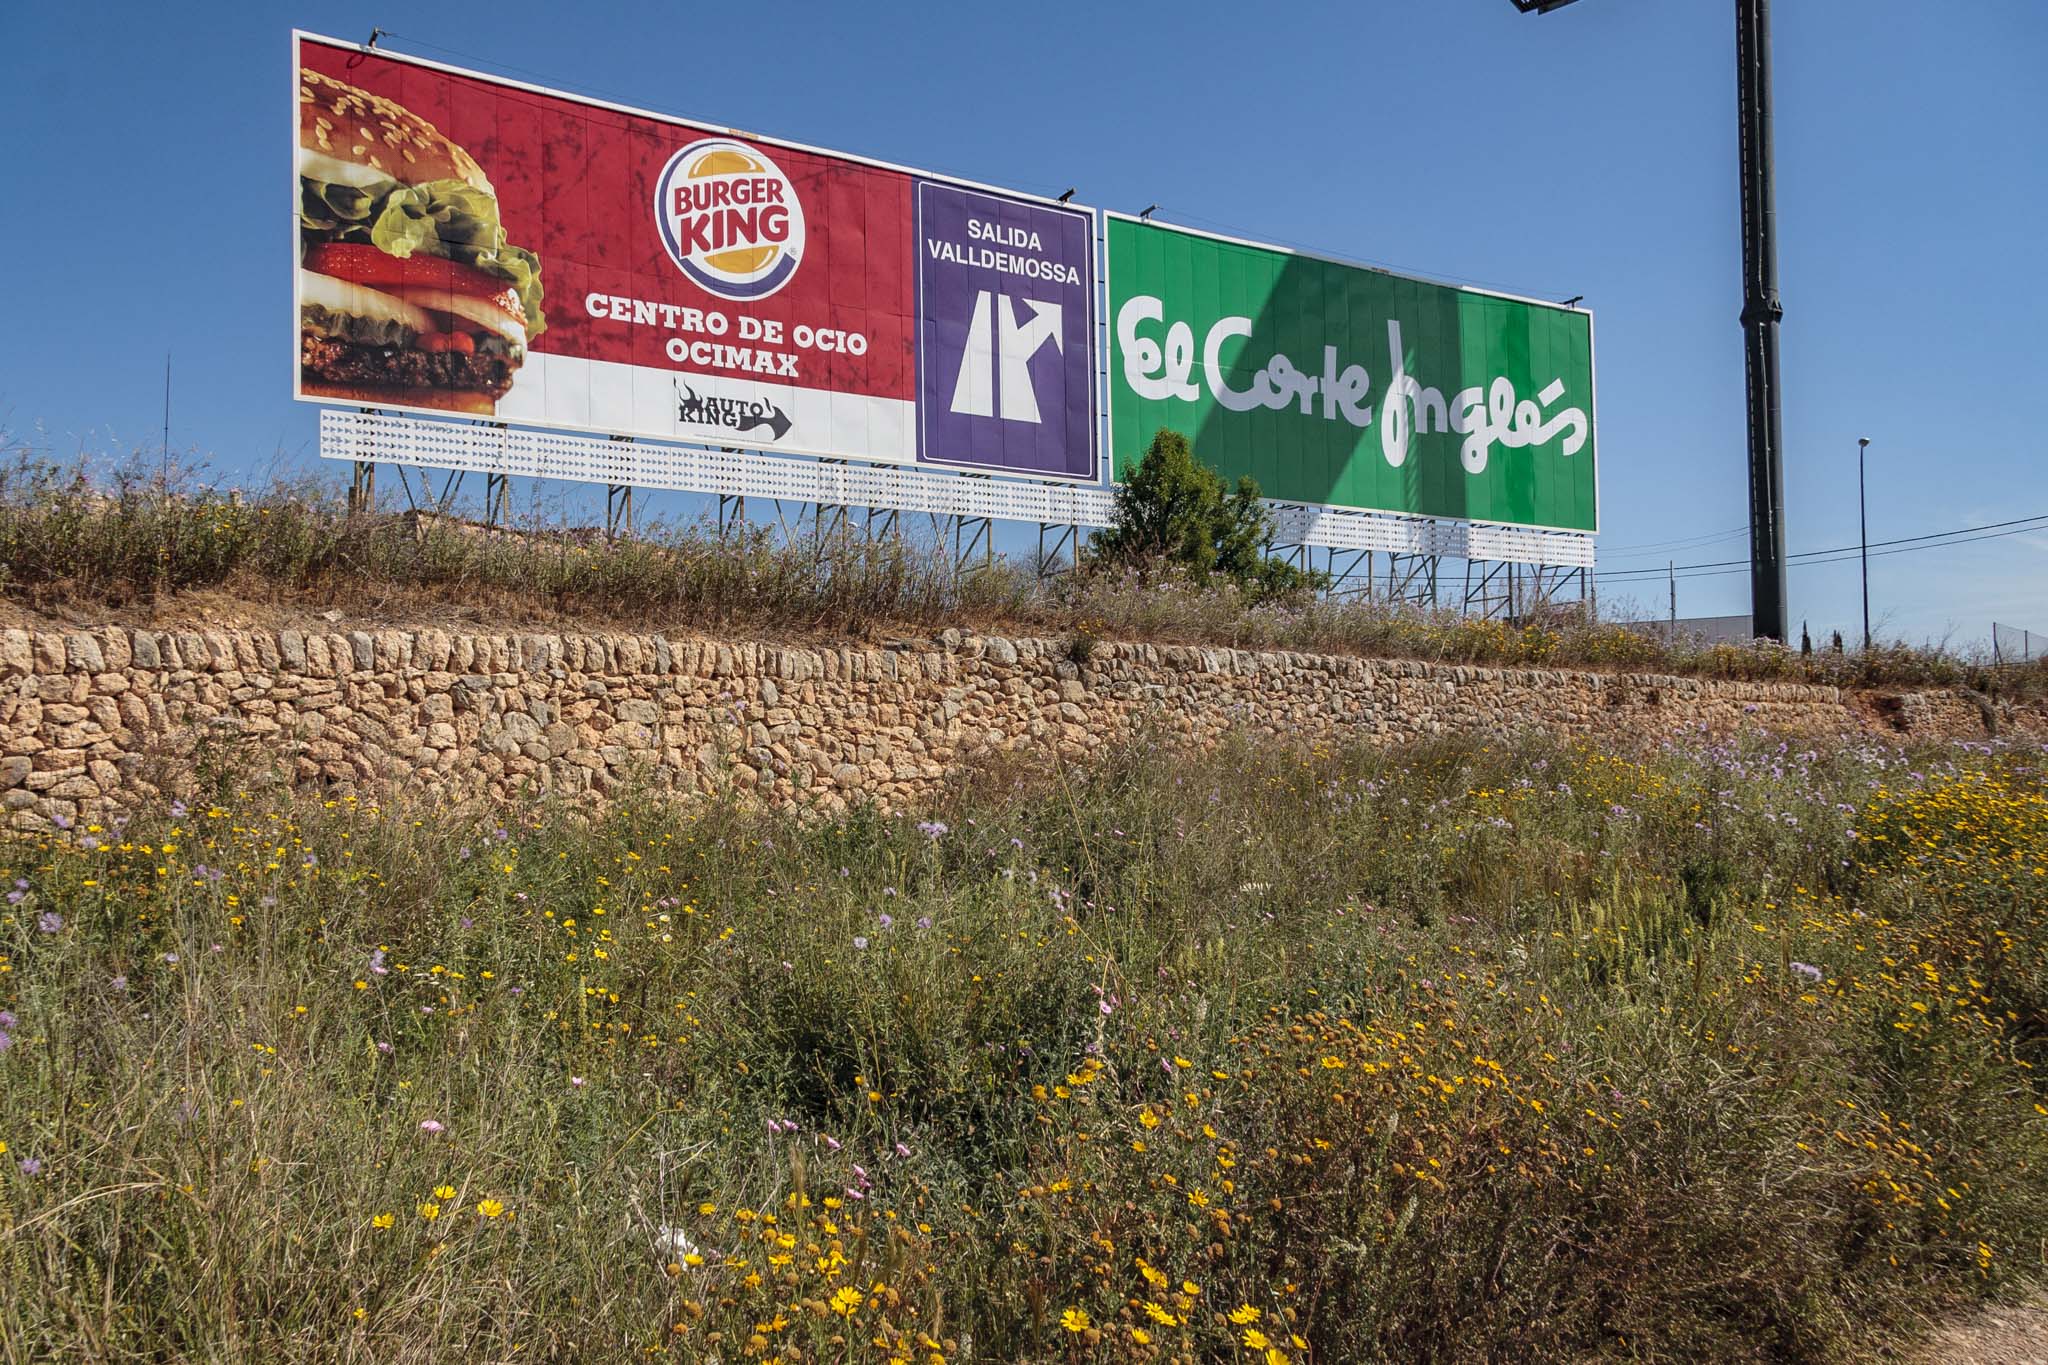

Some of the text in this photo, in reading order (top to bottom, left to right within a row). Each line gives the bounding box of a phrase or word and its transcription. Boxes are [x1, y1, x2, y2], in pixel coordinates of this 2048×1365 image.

[674, 178, 785, 216] BURGER
[680, 204, 789, 257] KING
[967, 219, 1043, 252] SALIDA
[927, 238, 1081, 286] VALLDEMOSSA
[585, 293, 868, 356] CENTRO DE OCIO
[666, 338, 799, 378] OCIMAX
[1117, 295, 1588, 475] El Corte Inglés
[679, 404, 738, 427] KING
[704, 397, 764, 417] AUTO
